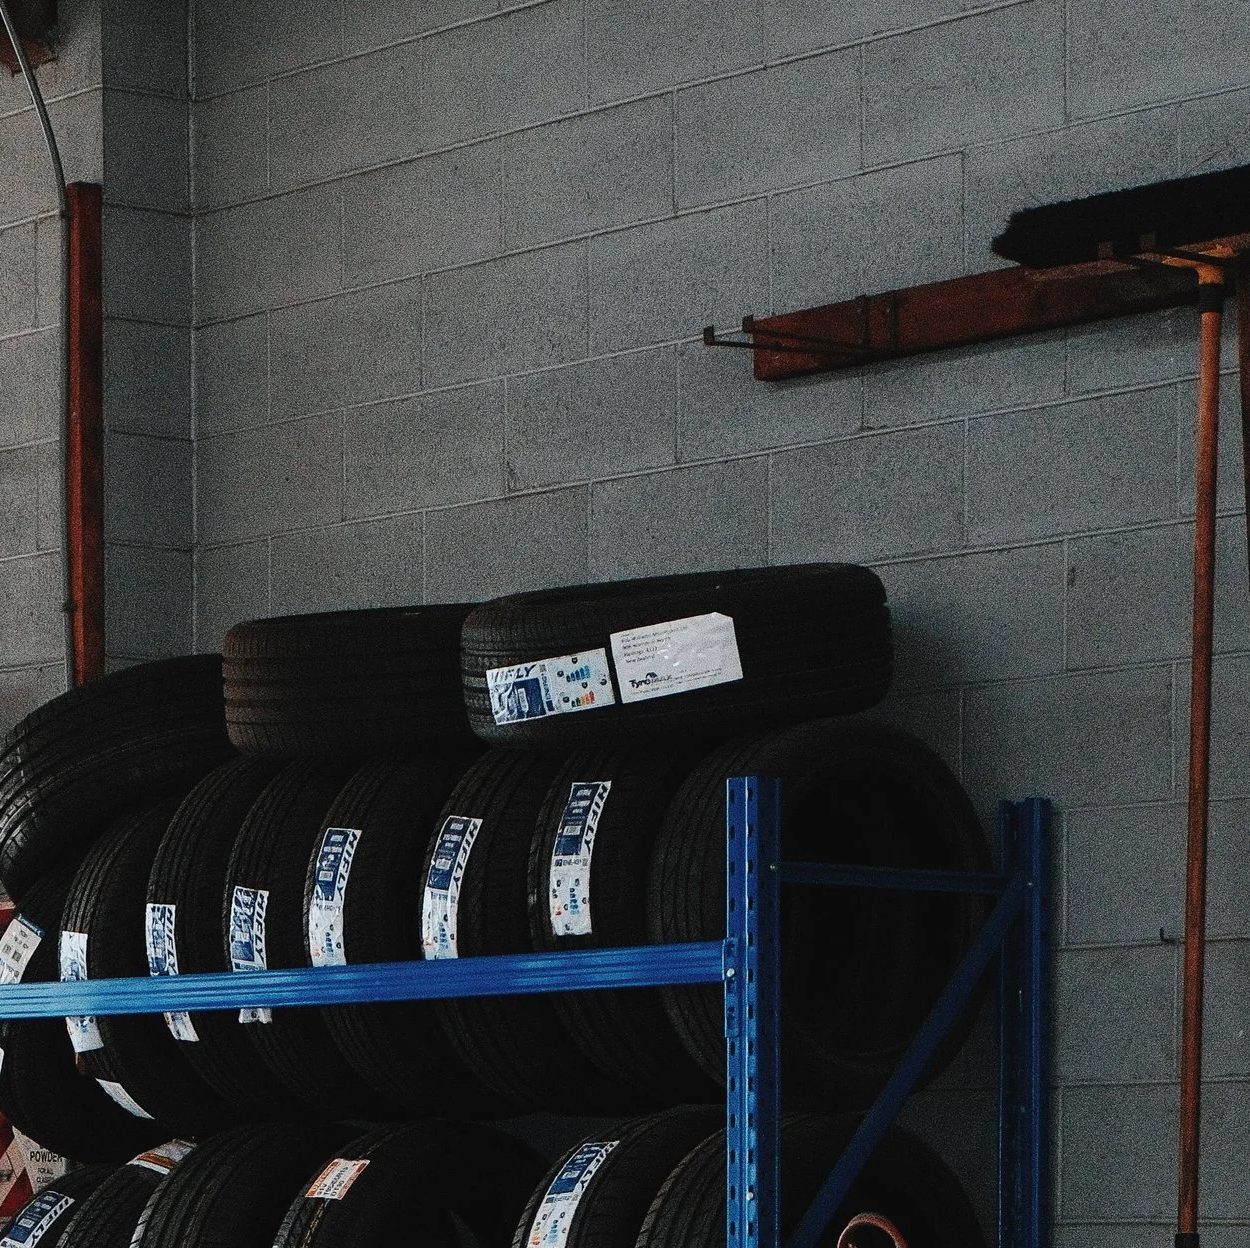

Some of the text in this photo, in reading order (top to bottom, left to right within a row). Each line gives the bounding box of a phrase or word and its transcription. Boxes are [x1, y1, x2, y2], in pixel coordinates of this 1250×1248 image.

[584, 784, 610, 856] HIFLY
[336, 831, 358, 901] HIFLY
[453, 821, 479, 893] HIFLY
[166, 907, 177, 974] HIFLY
[254, 892, 266, 965] HIFLY
[31, 1197, 70, 1248] HIFLY
